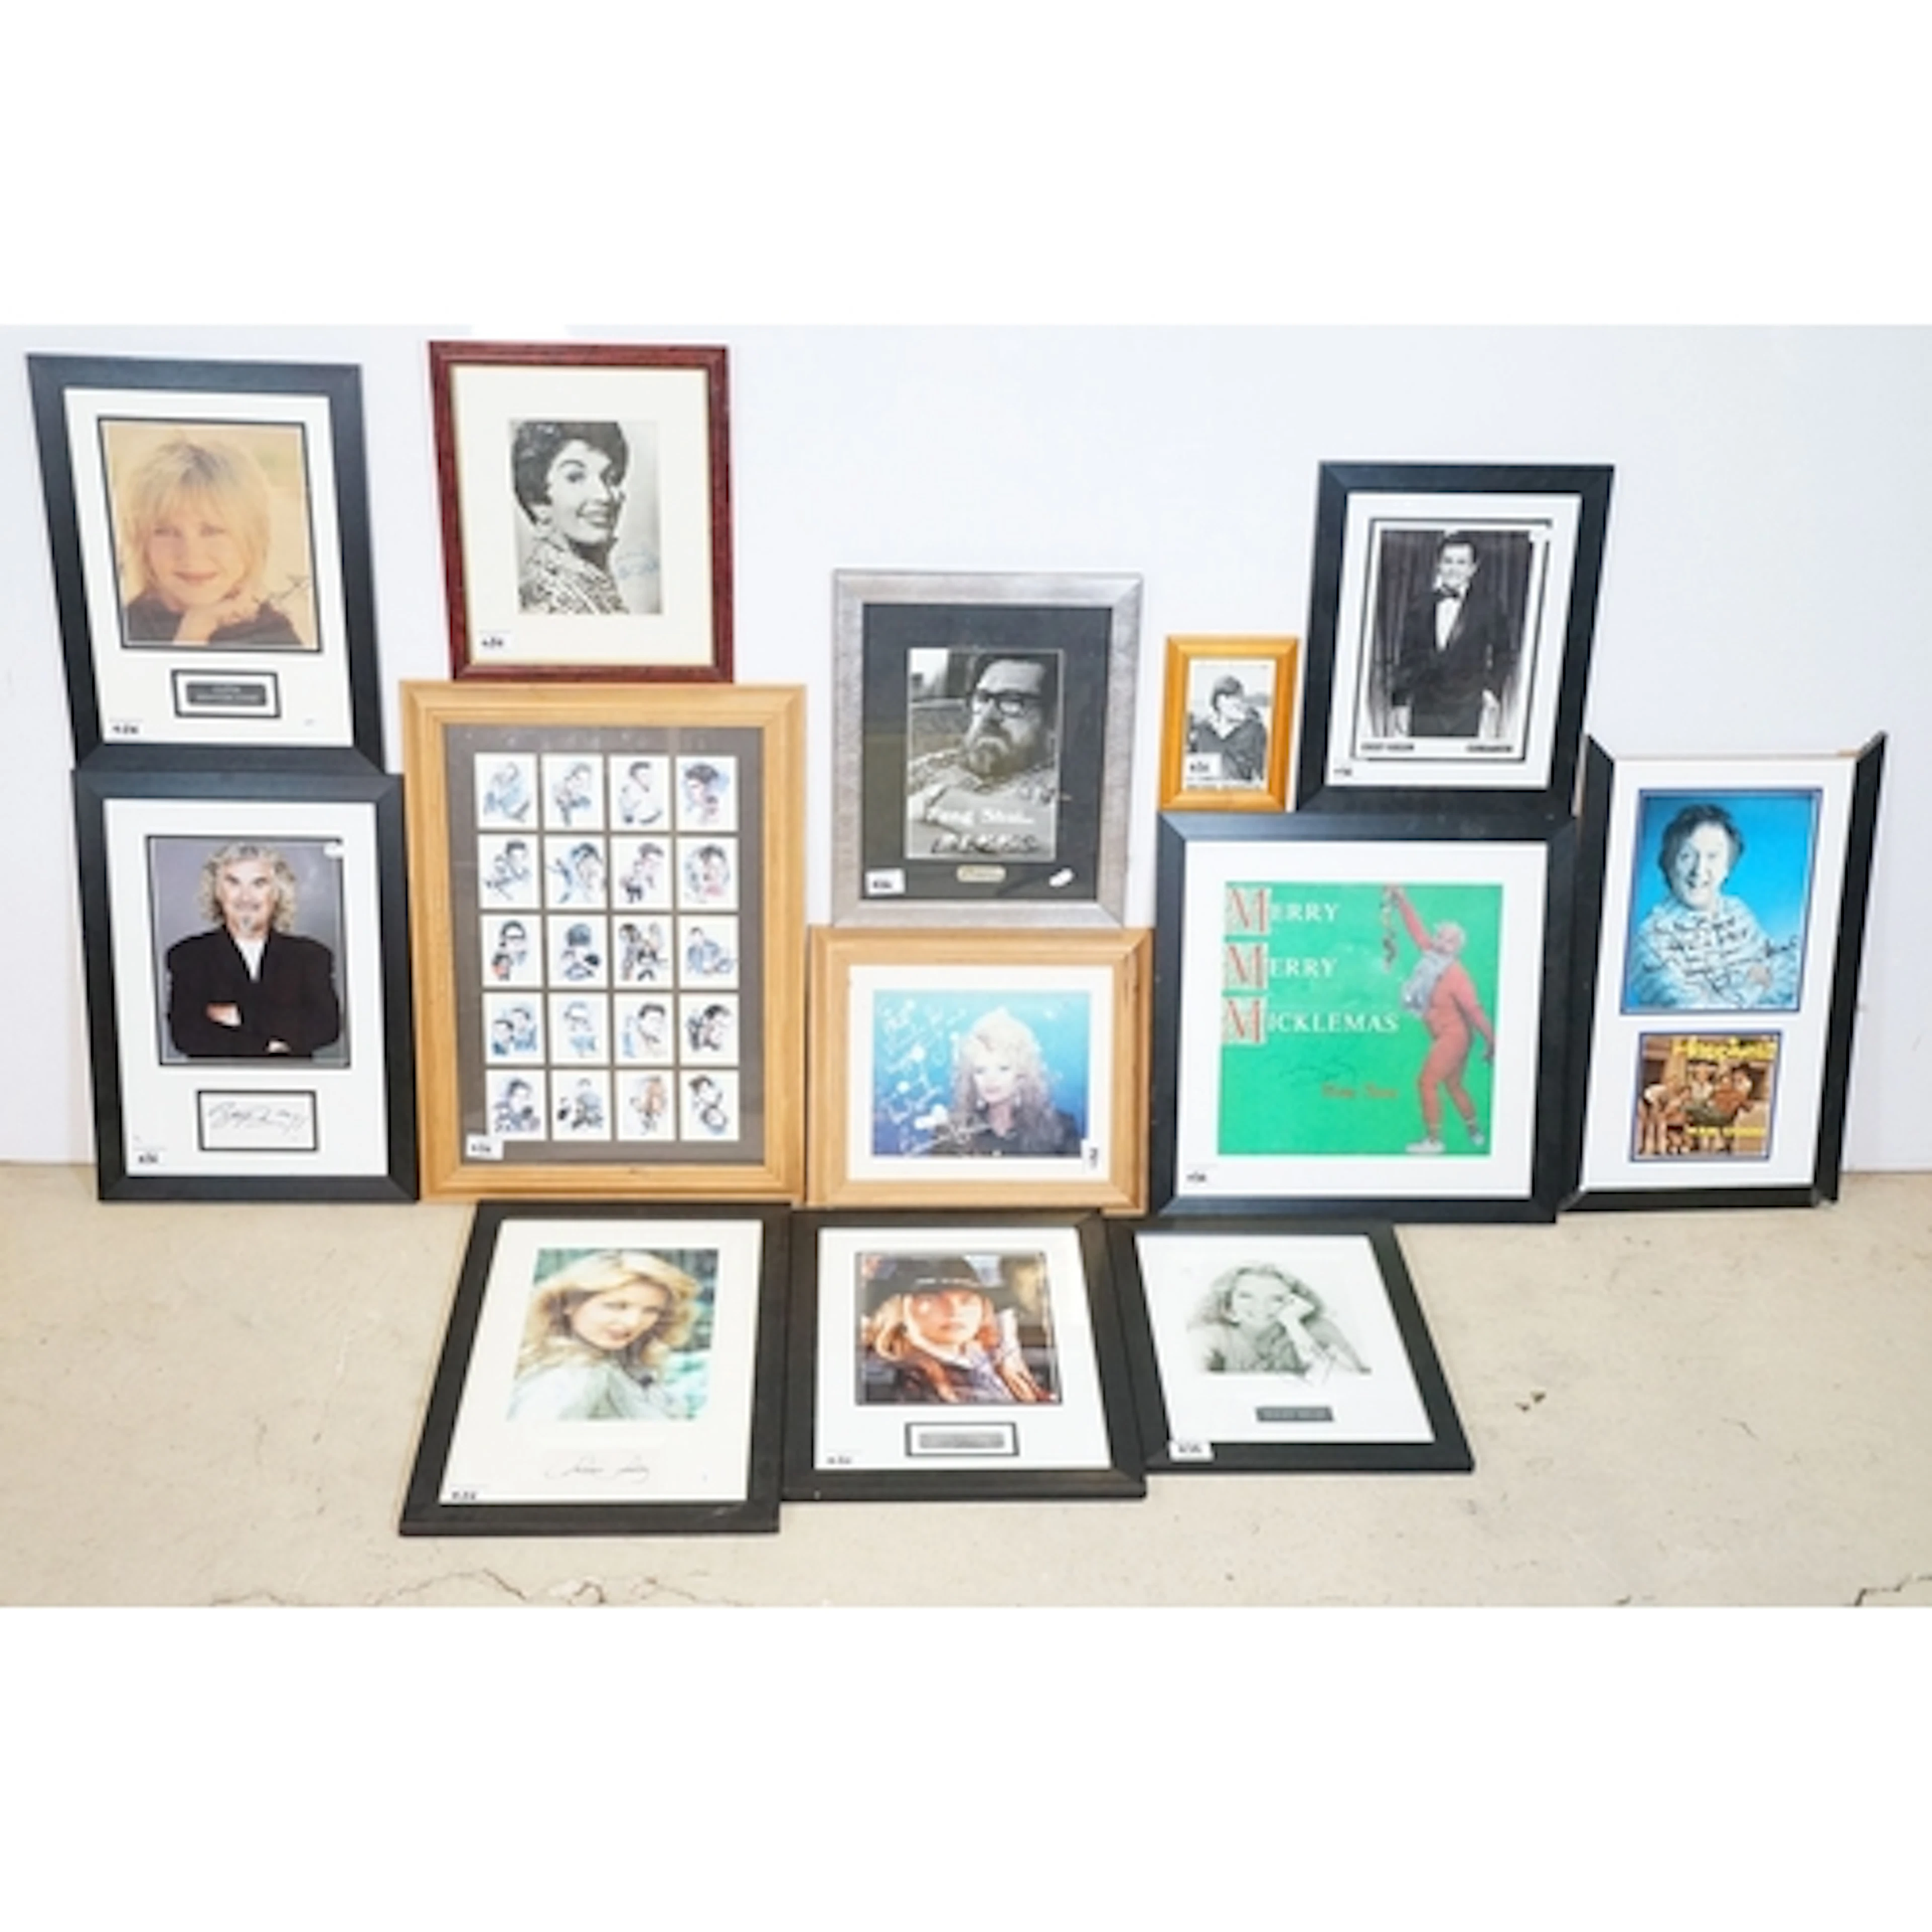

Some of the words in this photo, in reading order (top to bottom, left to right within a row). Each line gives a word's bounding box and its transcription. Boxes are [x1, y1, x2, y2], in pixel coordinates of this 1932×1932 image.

[1228, 888, 1340, 933] MERRY
[1227, 944, 1338, 988] MERRY
[1226, 999, 1401, 1043] MICKLEMAS
